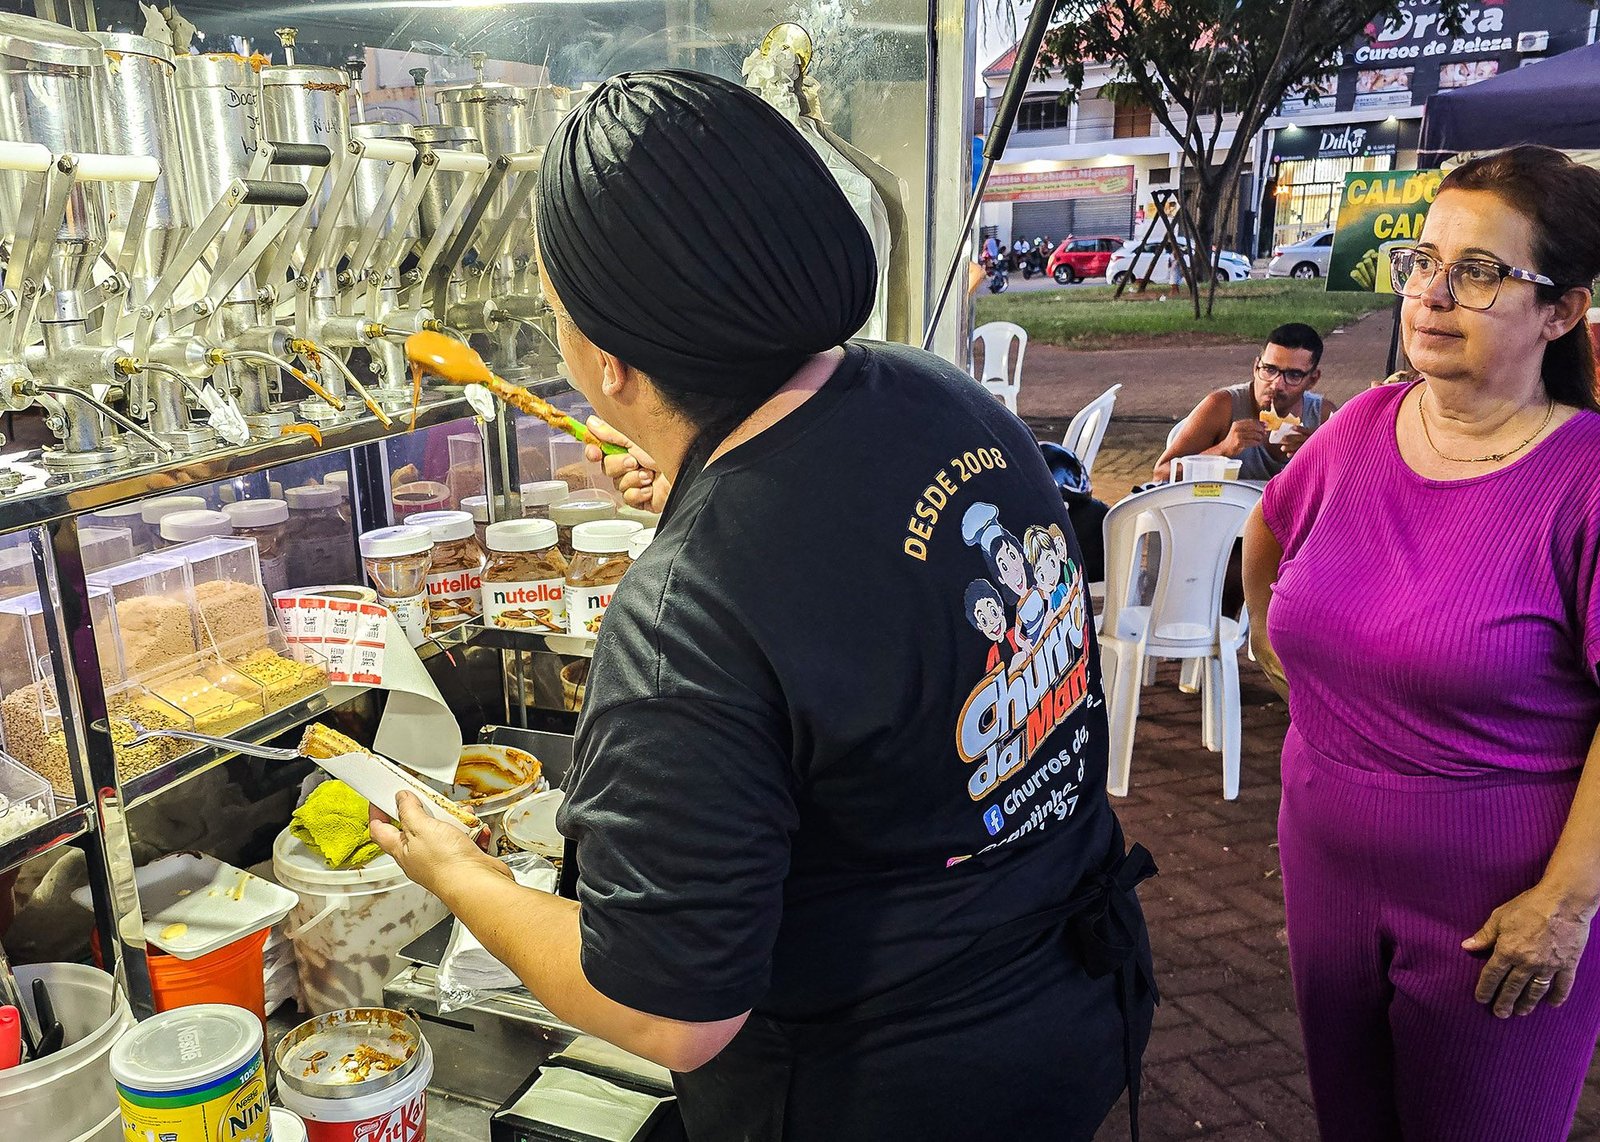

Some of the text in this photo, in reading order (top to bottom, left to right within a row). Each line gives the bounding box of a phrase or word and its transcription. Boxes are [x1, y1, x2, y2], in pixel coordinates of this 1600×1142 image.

[1355, 45, 1418, 63] Cursos
[1423, 40, 1447, 57] de
[1450, 36, 1512, 55] Beleza
[1347, 177, 1440, 205] CALDO
[904, 447, 1007, 561] DESDE 2008
[494, 584, 562, 604] nutella
[969, 734, 1021, 798] da
[1003, 749, 1071, 815] Churros
[177, 1025, 202, 1064] Nestlé
[239, 1067, 255, 1084] 10%
[236, 1085, 259, 1111] Nestlé
